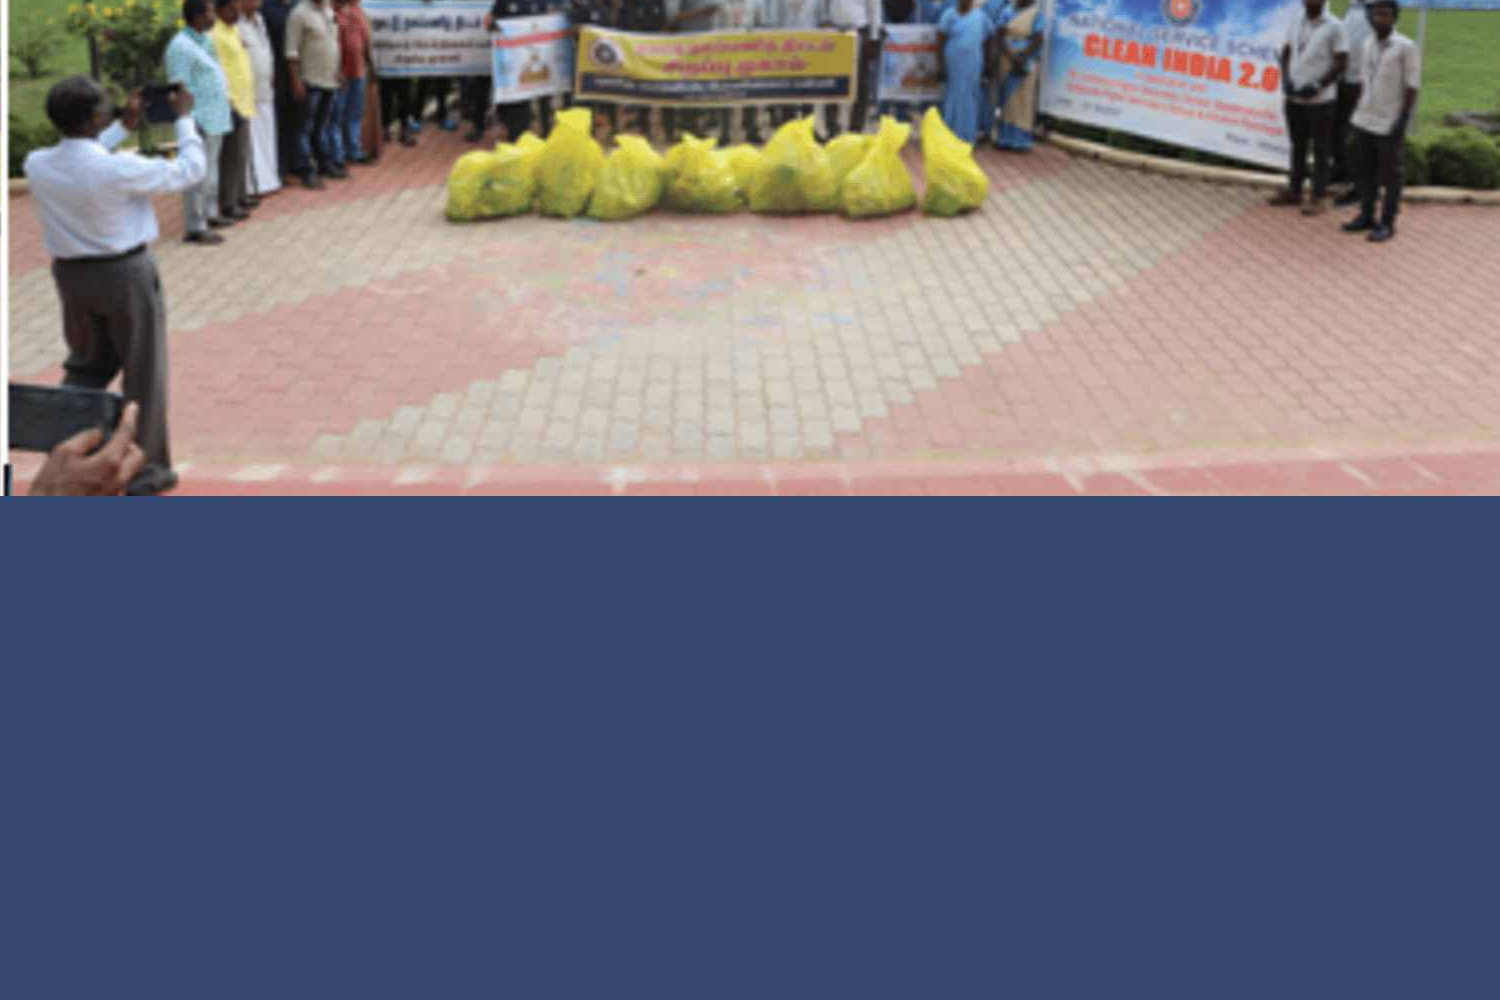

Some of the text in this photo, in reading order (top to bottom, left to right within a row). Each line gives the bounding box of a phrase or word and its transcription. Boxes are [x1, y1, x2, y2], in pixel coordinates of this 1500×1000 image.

[1082, 32, 1158, 69] CLEAN
[1162, 46, 1232, 84] INDIA
[1237, 60, 1281, 94] 2.0
